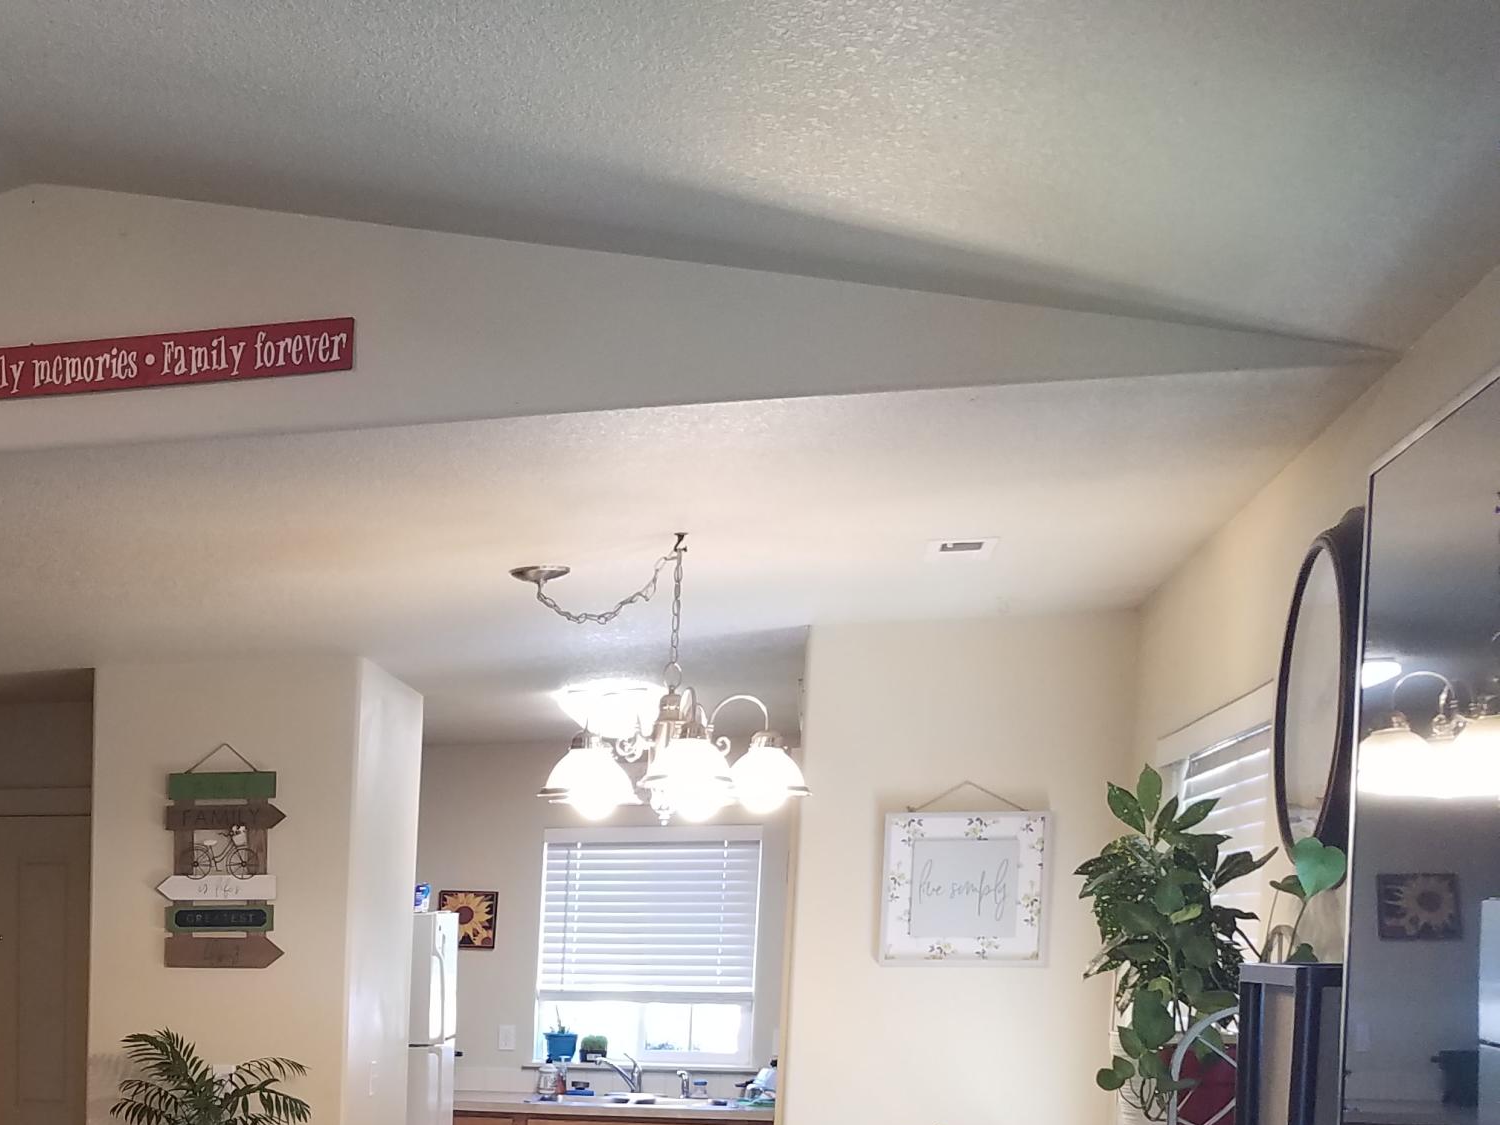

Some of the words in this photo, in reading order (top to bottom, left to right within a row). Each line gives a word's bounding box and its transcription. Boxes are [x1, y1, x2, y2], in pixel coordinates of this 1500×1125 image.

[32, 346, 138, 388] memories
[161, 335, 247, 375] Family
[254, 331, 347, 370] forever
[182, 808, 260, 827] FAMILY
[918, 858, 944, 905] live
[949, 858, 1010, 922] simply
